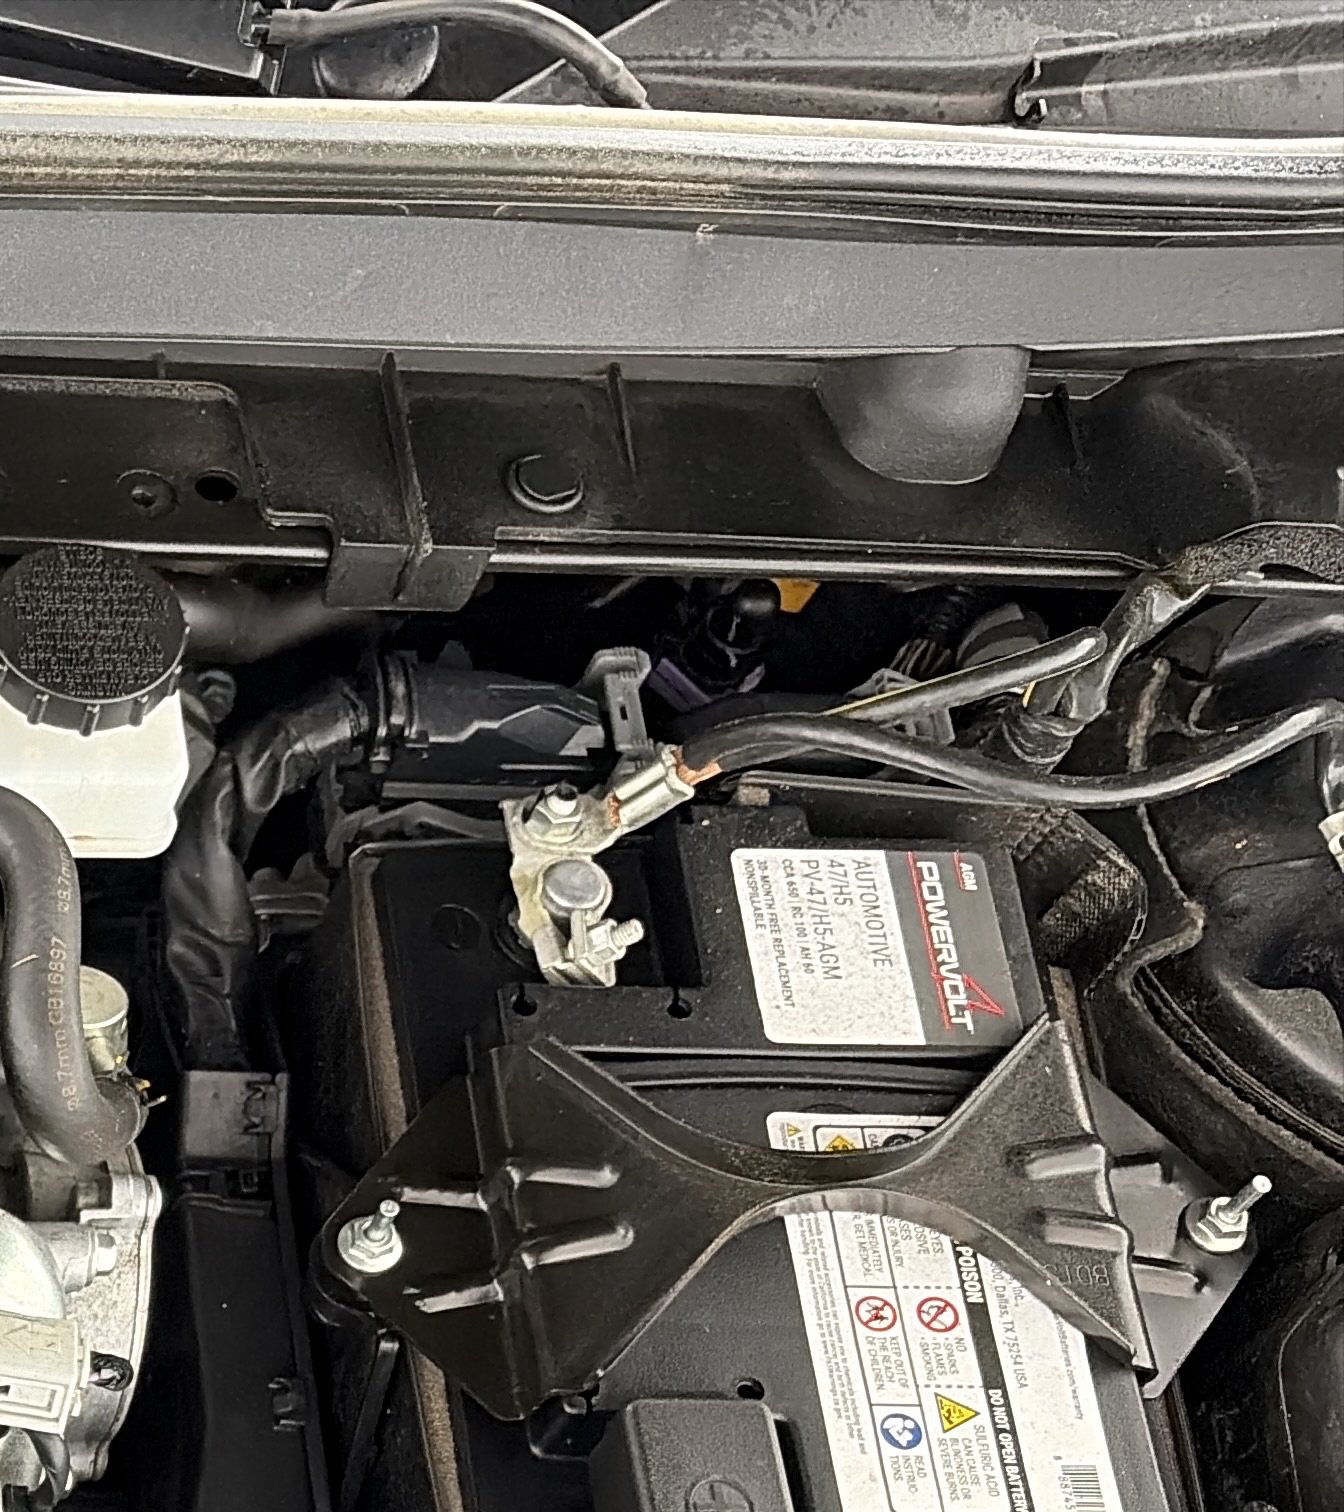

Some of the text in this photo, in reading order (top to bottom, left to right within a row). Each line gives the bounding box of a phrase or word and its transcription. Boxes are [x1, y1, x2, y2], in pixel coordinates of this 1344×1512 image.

[827, 859, 853, 906] 47/H5
[959, 862, 978, 891] AGM
[744, 858, 766, 930] NONSPILLABLE
[767, 912, 781, 935] FREE
[782, 859, 815, 975] CCA 650 RC 100 AH 60
[800, 859, 842, 980] PV-47/H5-AGM
[852, 859, 893, 968] AUTOMOTIVE
[916, 860, 975, 1034] POWERVOLT
[773, 937, 795, 1009] REPLACEMENT
[955, 1246, 983, 1303] POISON
[1004, 1320, 1015, 1333] TX
[954, 1337, 966, 1351] NO
[1008, 1335, 1023, 1365] 75254
[1016, 1368, 1029, 1388] USA
[988, 1389, 1004, 1404] DO
[992, 1406, 1010, 1429] NOT
[973, 1424, 999, 1497] SULFURIC ACID
[998, 1433, 1017, 1463] OPEN
[912, 1455, 926, 1478] READ
